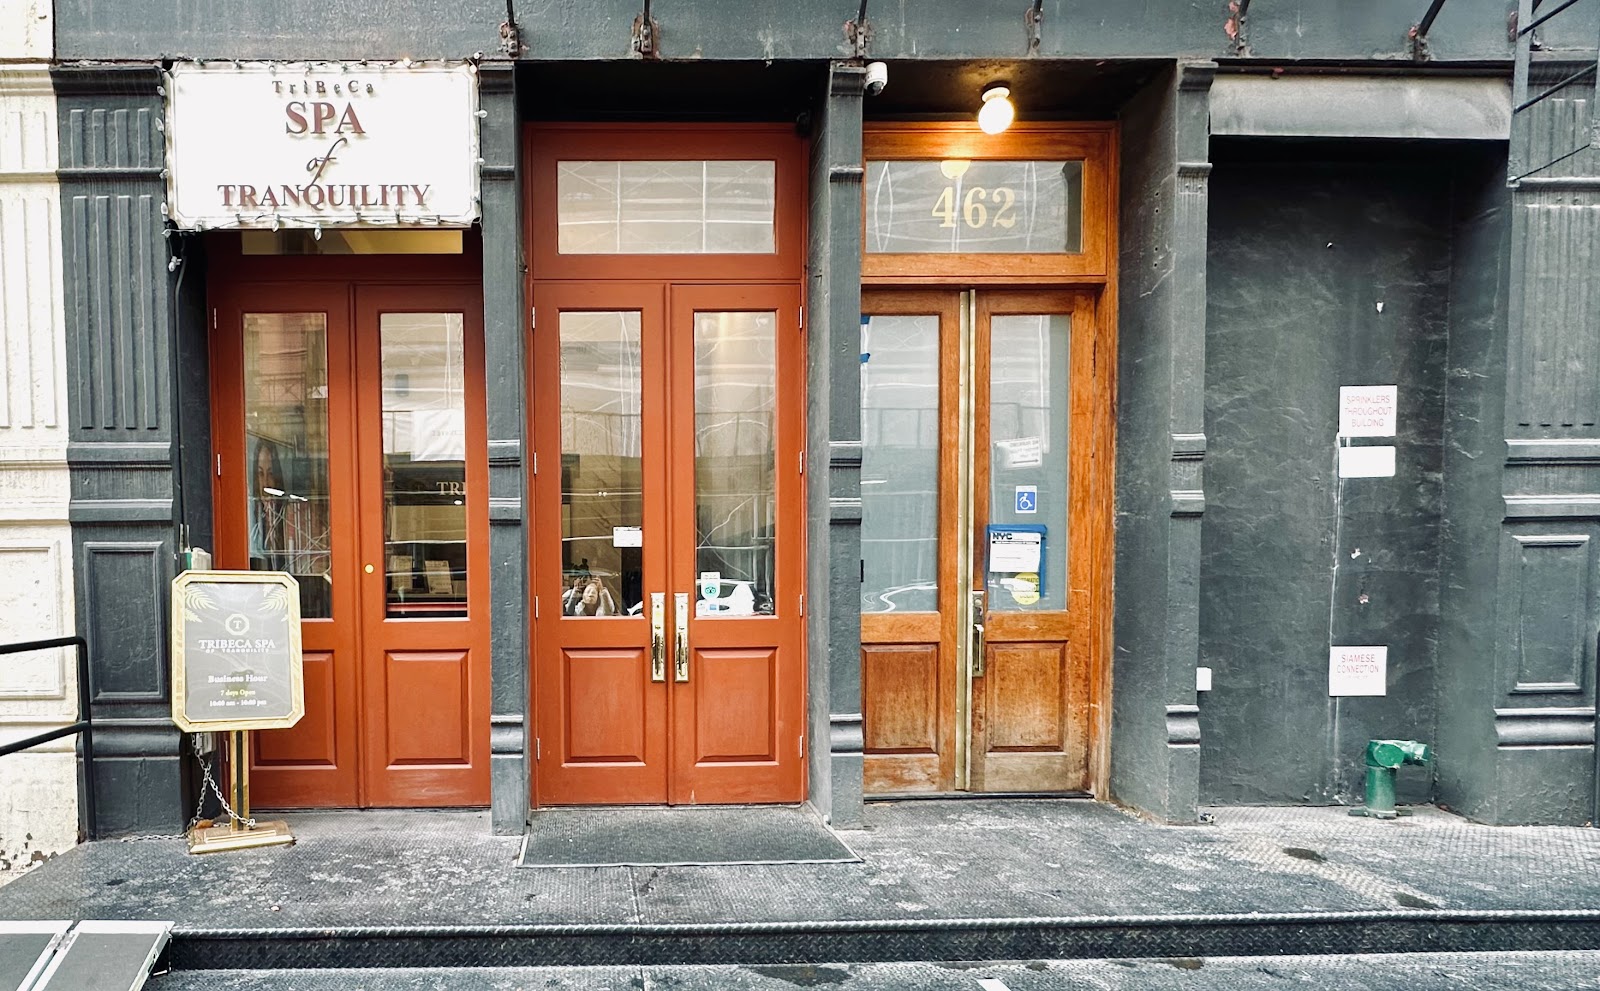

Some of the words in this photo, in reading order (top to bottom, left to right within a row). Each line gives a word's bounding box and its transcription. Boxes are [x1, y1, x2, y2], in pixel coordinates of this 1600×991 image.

[271, 80, 375, 94] TriBeCa
[285, 101, 366, 135] SPA
[298, 137, 348, 191] of
[217, 184, 431, 211] TRANQUILITY
[931, 186, 1016, 229] 462
[1346, 395, 1391, 405] SPRINKLERS
[1344, 406, 1392, 416] THROUGHOUT
[1351, 418, 1384, 427] BUILDING
[992, 532, 1013, 540] NYC
[233, 620, 242, 629] T
[198, 639, 252, 649] TRIBECA
[255, 639, 276, 649] SPA
[1341, 653, 1375, 663] SIAMESE
[1336, 664, 1379, 674] CONNECTION
[207, 675, 244, 683] Business
[246, 674, 268, 682] Hour
[225, 689, 239, 697] days
[239, 689, 256, 697] Open
